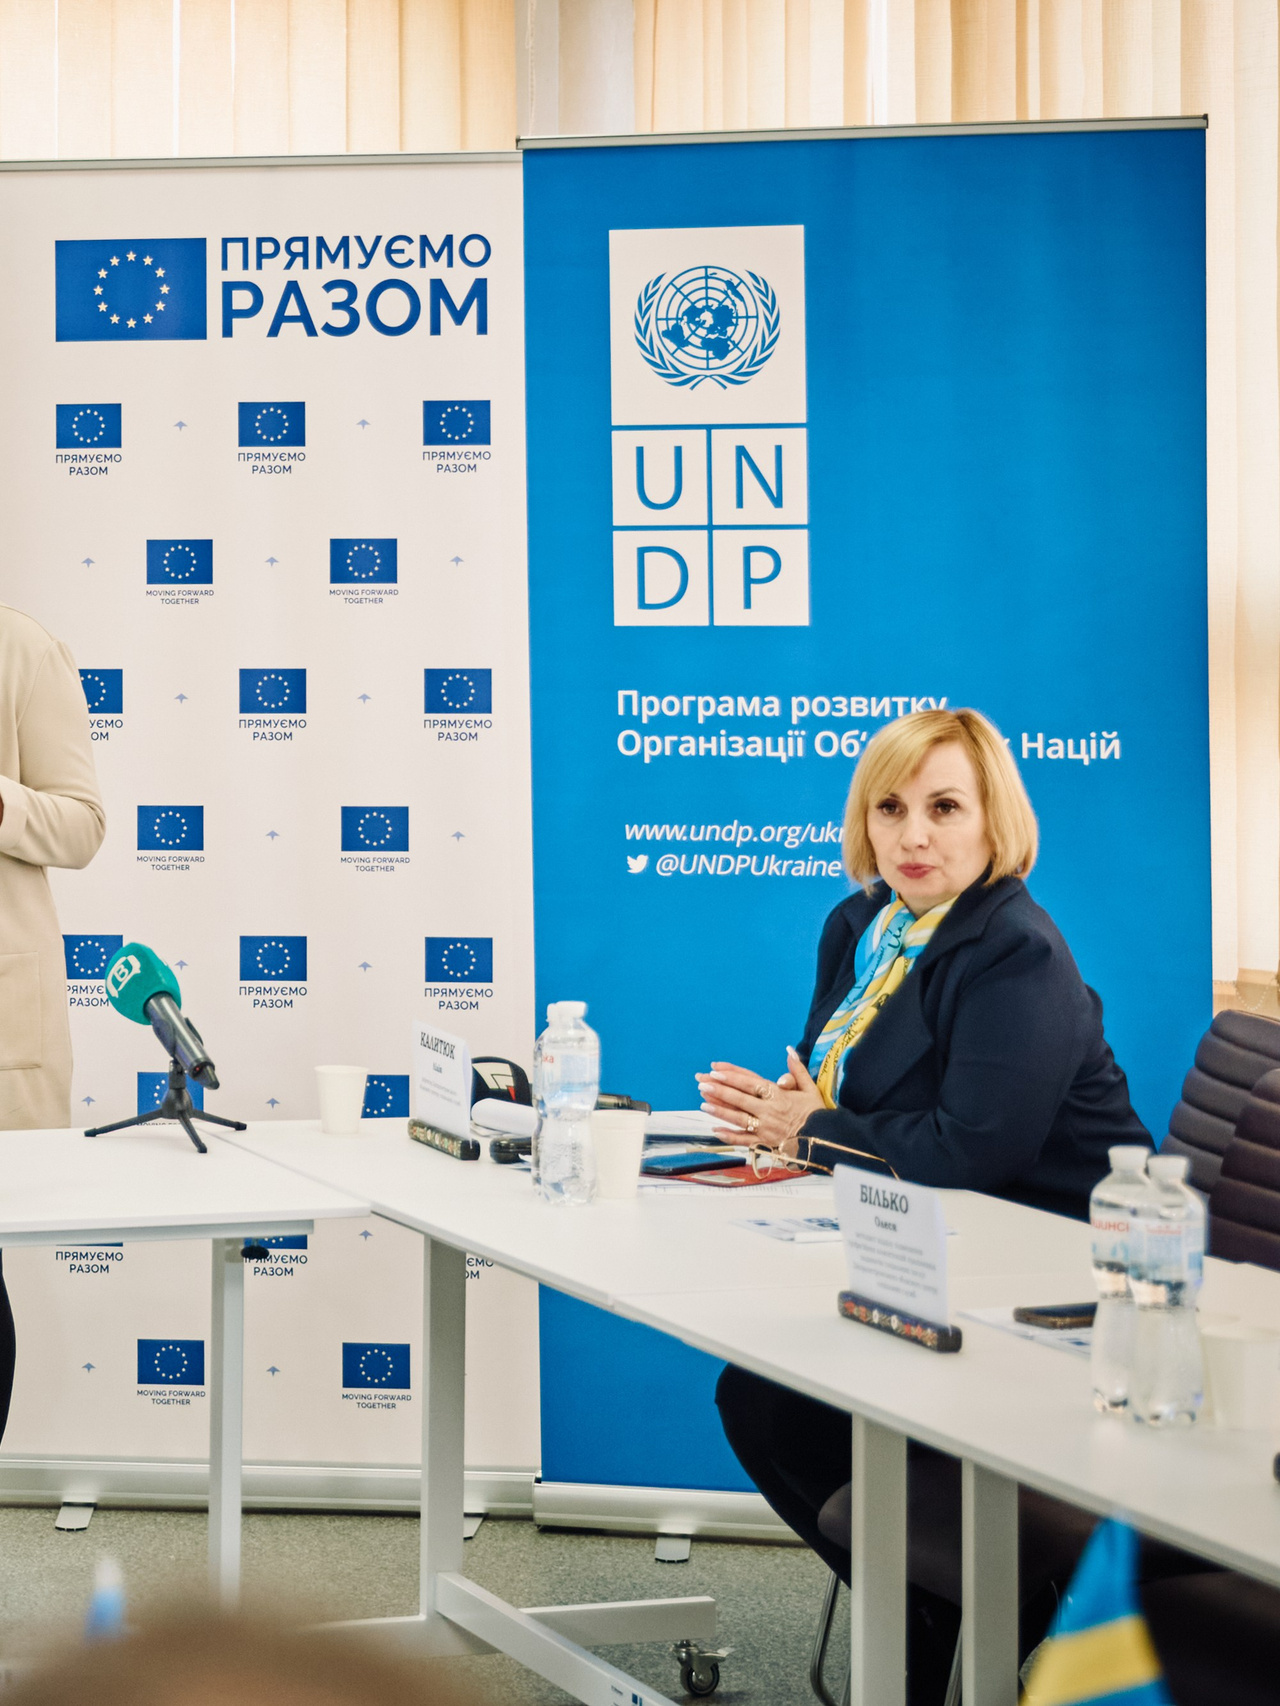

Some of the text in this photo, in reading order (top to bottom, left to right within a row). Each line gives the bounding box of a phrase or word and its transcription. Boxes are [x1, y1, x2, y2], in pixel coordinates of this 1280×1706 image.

[221, 233, 491, 271] ПРЯМУЄМО
[221, 278, 488, 338] РАЗОМ
[55, 453, 123, 464] ПРЯМУЄМО
[237, 451, 307, 463] ПРЯМУЄМО
[421, 450, 492, 461] ПРЯМУЄМО
[68, 465, 109, 477] РАЗОМ
[251, 464, 293, 475] РАЗОМ
[436, 463, 478, 474] РАЗОМ
[146, 589, 214, 597] MOVING FORWARD
[329, 588, 399, 597] MOVING FORWARD
[160, 597, 199, 606] TOGETHER
[344, 596, 384, 605] TOGETHER
[617, 690, 781, 724] Програма
[238, 718, 308, 730] ПРЯМУЄМО
[423, 718, 493, 730] ПРЯМУЄМО
[252, 731, 294, 742] РАЗОМ
[437, 731, 479, 742] РАЗОМ
[617, 729, 807, 764] Організації
[1021, 731, 1121, 766] Націй
[625, 820, 843, 849] www.undp.org/ukr
[137, 855, 205, 864] MOVING FORWARD
[340, 856, 410, 865] MOVING FORWARD
[656, 853, 843, 877] @UNDPUkraine
[151, 863, 190, 872] TOGETHER
[355, 864, 395, 873] TOGETHER
[238, 985, 308, 997] ПРЯМУЄМО
[423, 987, 494, 999] ПРЯМУЄМО
[68, 996, 110, 1008] РАЗОМ
[252, 998, 294, 1010] РАЗОМ
[437, 999, 480, 1011] РАЗОМ
[860, 1184, 909, 1214] БІЛЬКО
[54, 1250, 125, 1262] ПРЯМУЄМО
[68, 1263, 110, 1275] РАЗОМ
[252, 1266, 295, 1278] РАЗОМ
[137, 1389, 206, 1398] MOVING FORWARD
[342, 1393, 412, 1402] MOVING FORWARD
[151, 1397, 191, 1406] TOGETHER
[356, 1401, 396, 1410] TOGETHER
